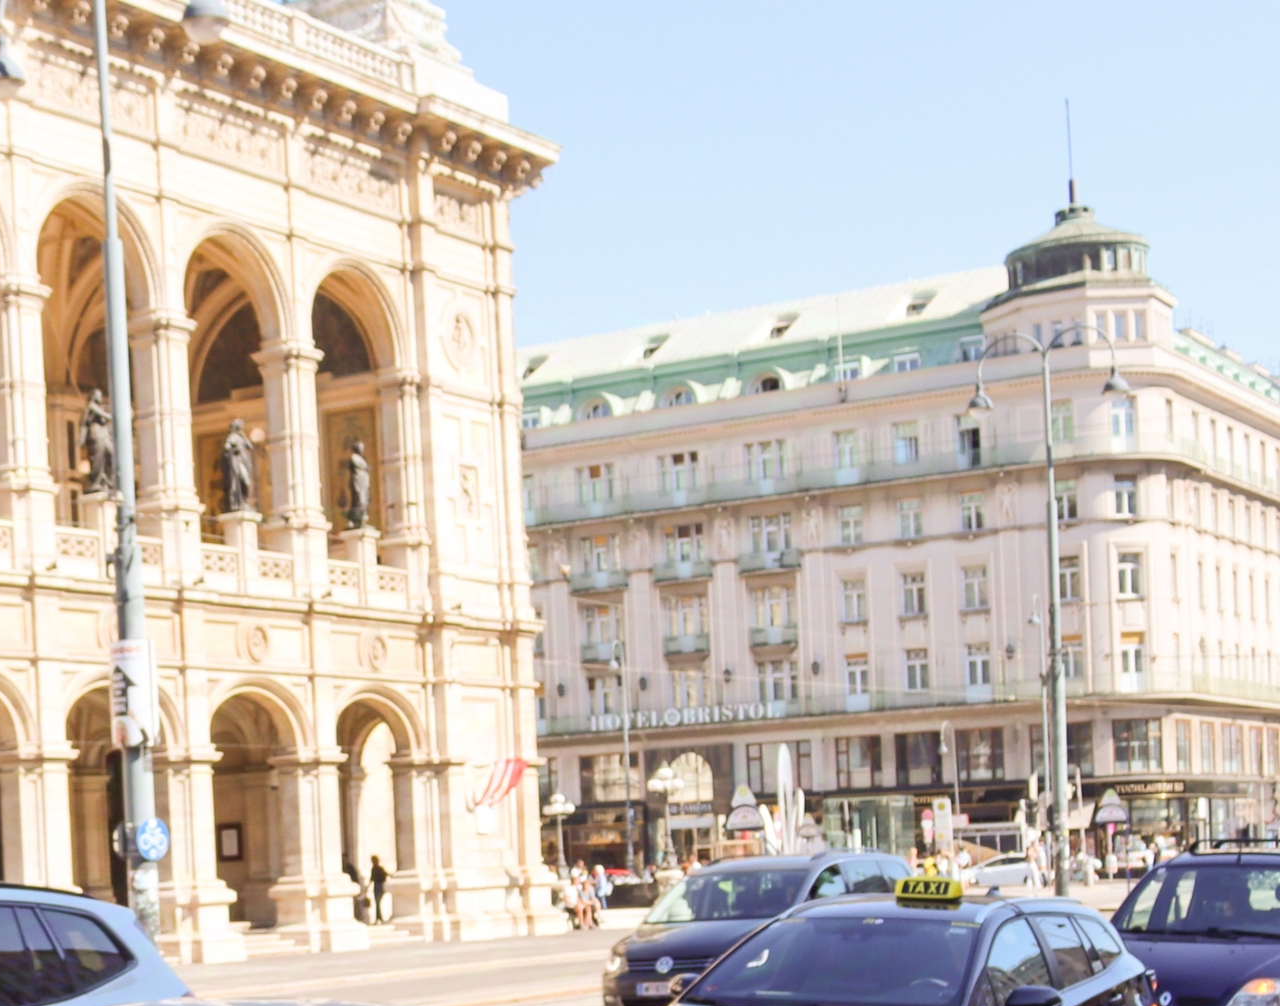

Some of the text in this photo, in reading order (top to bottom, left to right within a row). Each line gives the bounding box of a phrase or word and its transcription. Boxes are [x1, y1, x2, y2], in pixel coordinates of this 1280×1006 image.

[590, 702, 781, 732] HOTEL BRISTOL
[908, 881, 946, 894] TAXI
